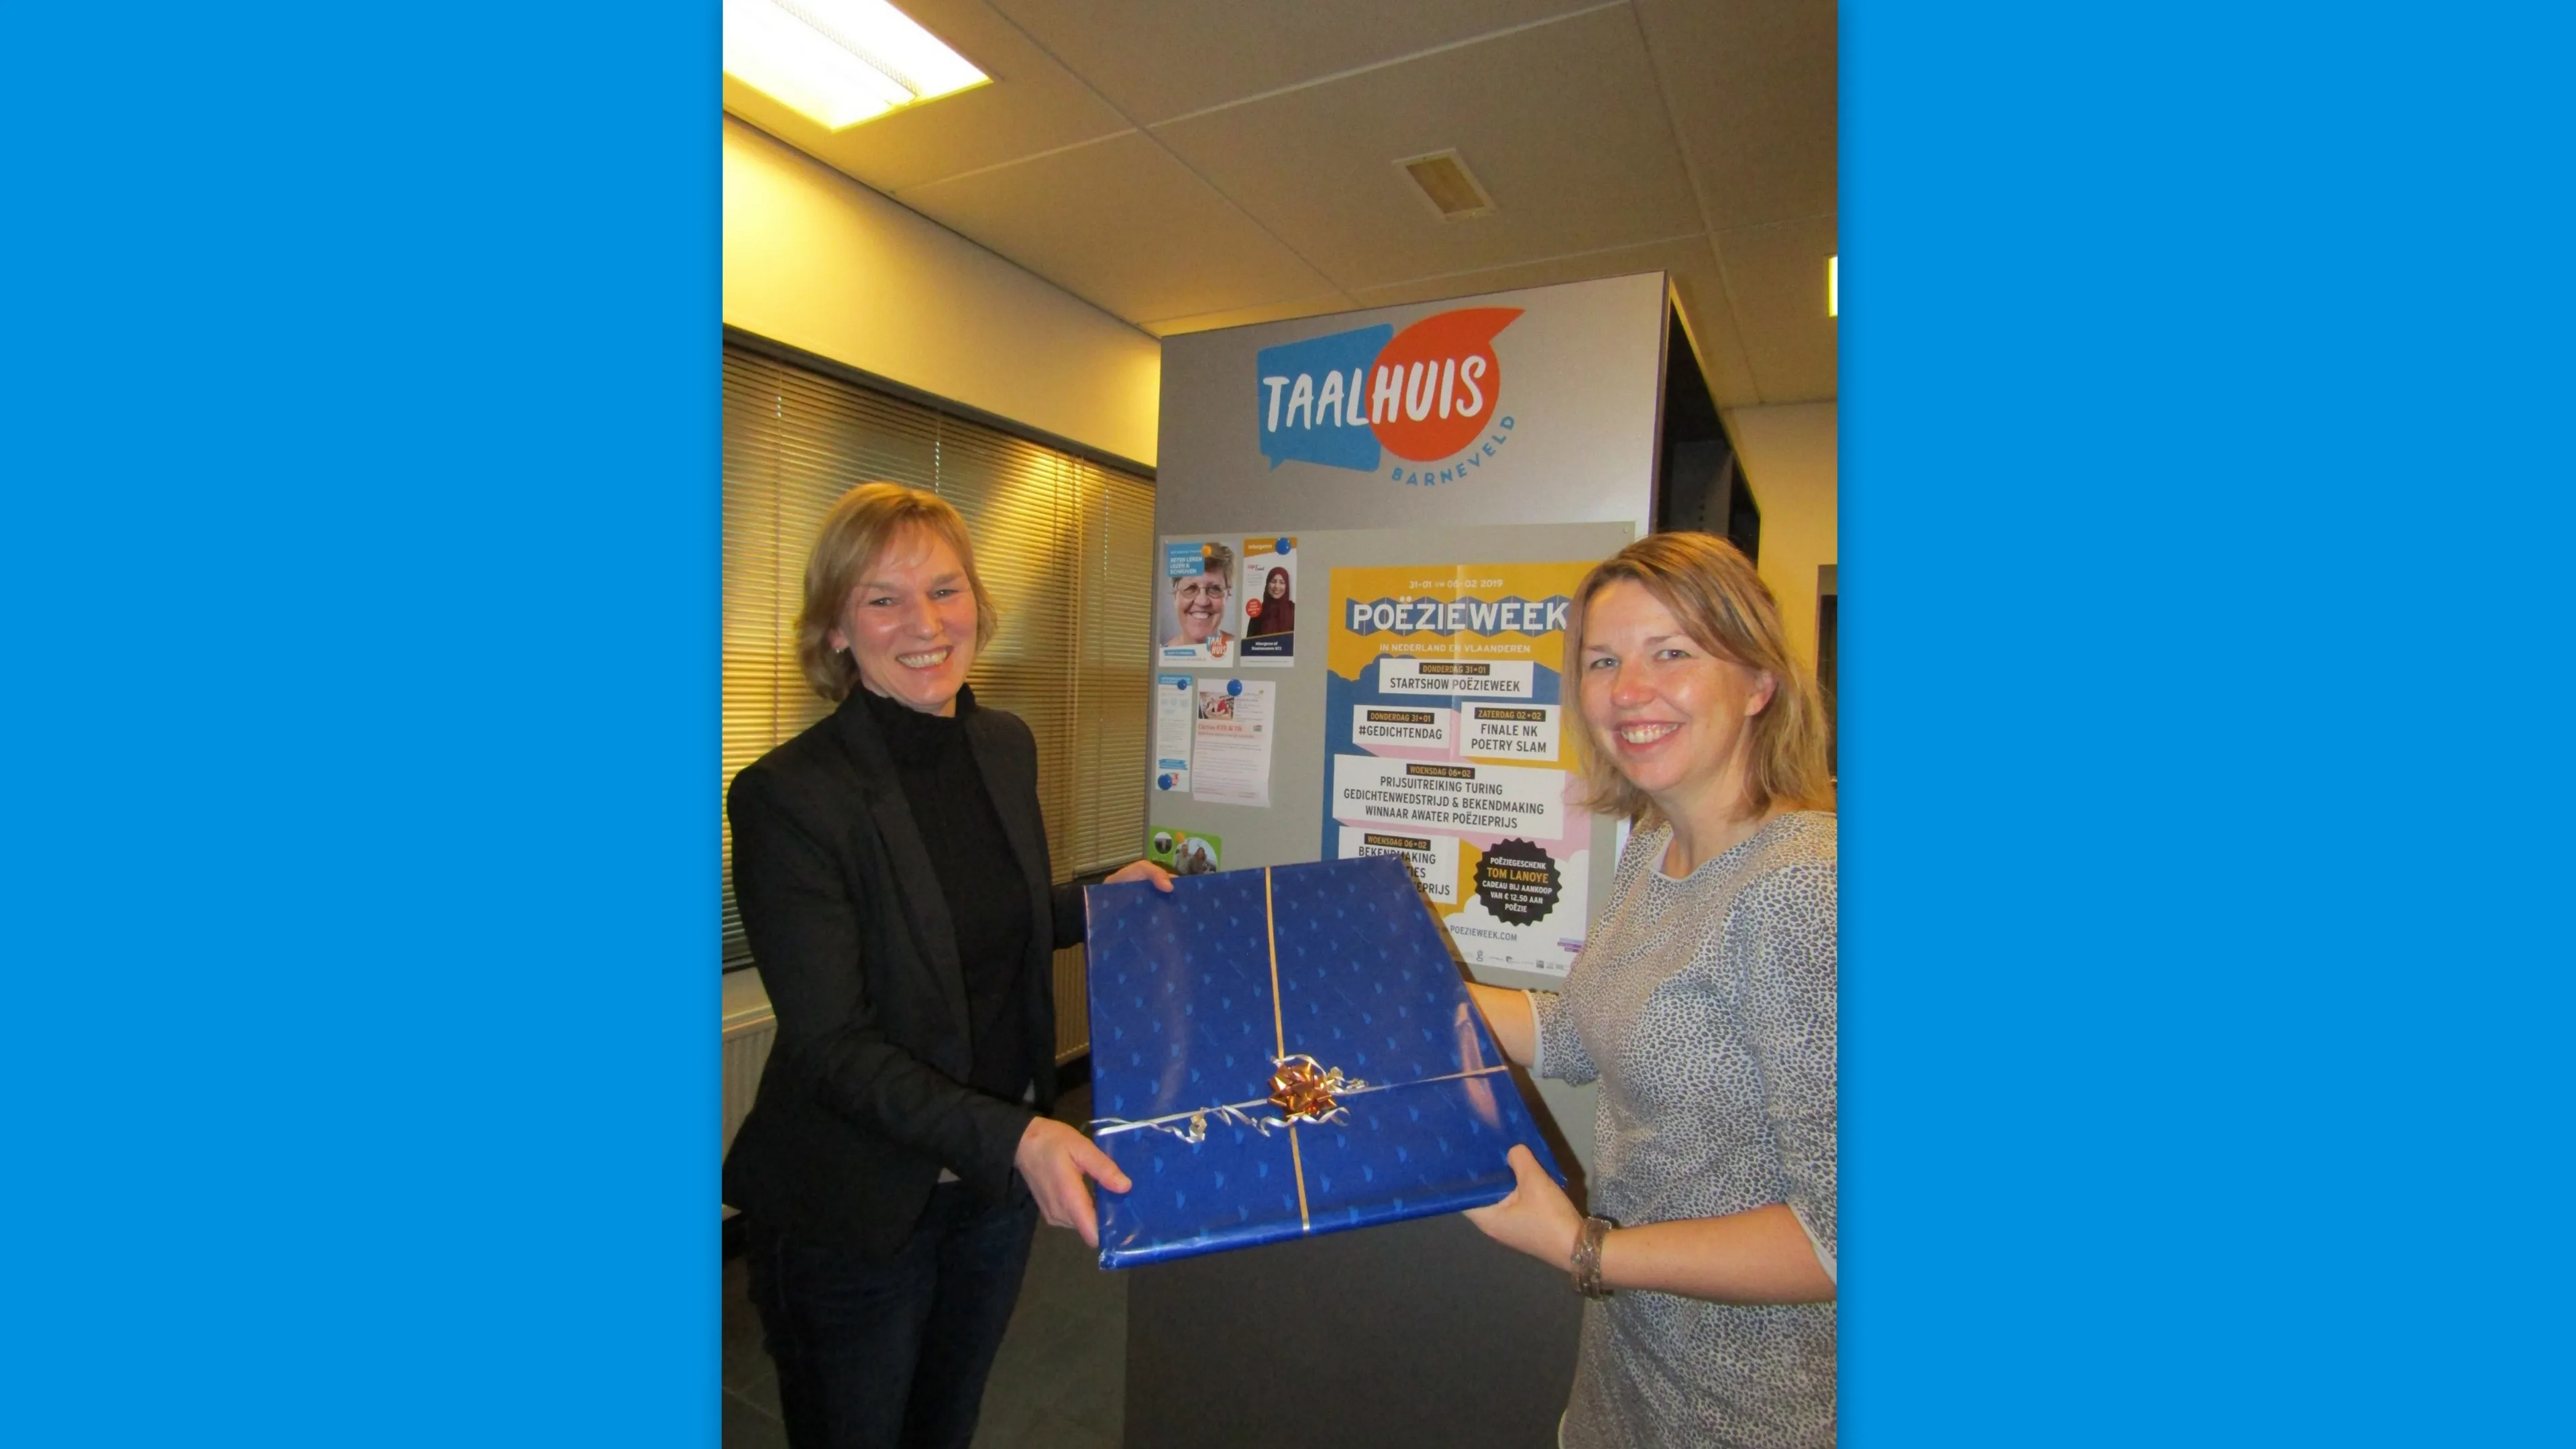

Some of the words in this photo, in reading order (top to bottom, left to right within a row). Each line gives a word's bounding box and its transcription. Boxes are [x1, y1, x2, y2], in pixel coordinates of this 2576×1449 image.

[1263, 355, 1486, 433] TAALHUIS
[1391, 415, 1515, 486] BARNEVELD
[1481, 579, 1503, 588] 2019
[1353, 596, 1569, 630] POËZIEWEEK
[1379, 643, 1389, 651] IN
[1392, 643, 1446, 652] NEDERLAND
[1449, 644, 1460, 653] EN
[1464, 645, 1531, 653] VLAANDEREN
[1423, 665, 1463, 674] DONDERDAG
[1390, 678, 1449, 690] STARTSHOW
[1452, 677, 1520, 692] POËZIEWEEK
[1371, 712, 1409, 722] DONDERDAG
[1478, 710, 1514, 718] ZATERDAG
[1358, 725, 1442, 740] #GEDICHTENDAG
[1481, 723, 1519, 737] FINALE
[1523, 725, 1538, 737] NK
[1471, 739, 1512, 751] POETRY
[1516, 740, 1546, 753] SLAM
[1410, 766, 1446, 775] WOENSDAG
[1381, 776, 1462, 792] PRIJSUITREIKING
[1465, 782, 1503, 796] TURING
[1344, 788, 1449, 807] GEDICHTENWEDSTRIJD
[1452, 797, 1459, 808] &
[1462, 798, 1544, 814] BEKENDMAKING
[1365, 805, 1409, 819] WINNAAR
[1411, 809, 1449, 823] AWATER
[1452, 812, 1517, 828] POËZIEPRIJS
[1367, 835, 1403, 847] WOENSDAG
[1490, 857, 1546, 870] POËZIEGESCHENK
[1487, 867, 1507, 878] TOM
[1510, 869, 1549, 883] LANOYE
[1482, 880, 1507, 890] CADEAU
[1509, 883, 1519, 891] BIJ
[1521, 885, 1552, 894] AANKOOP
[1505, 903, 1527, 912] POËZIE
